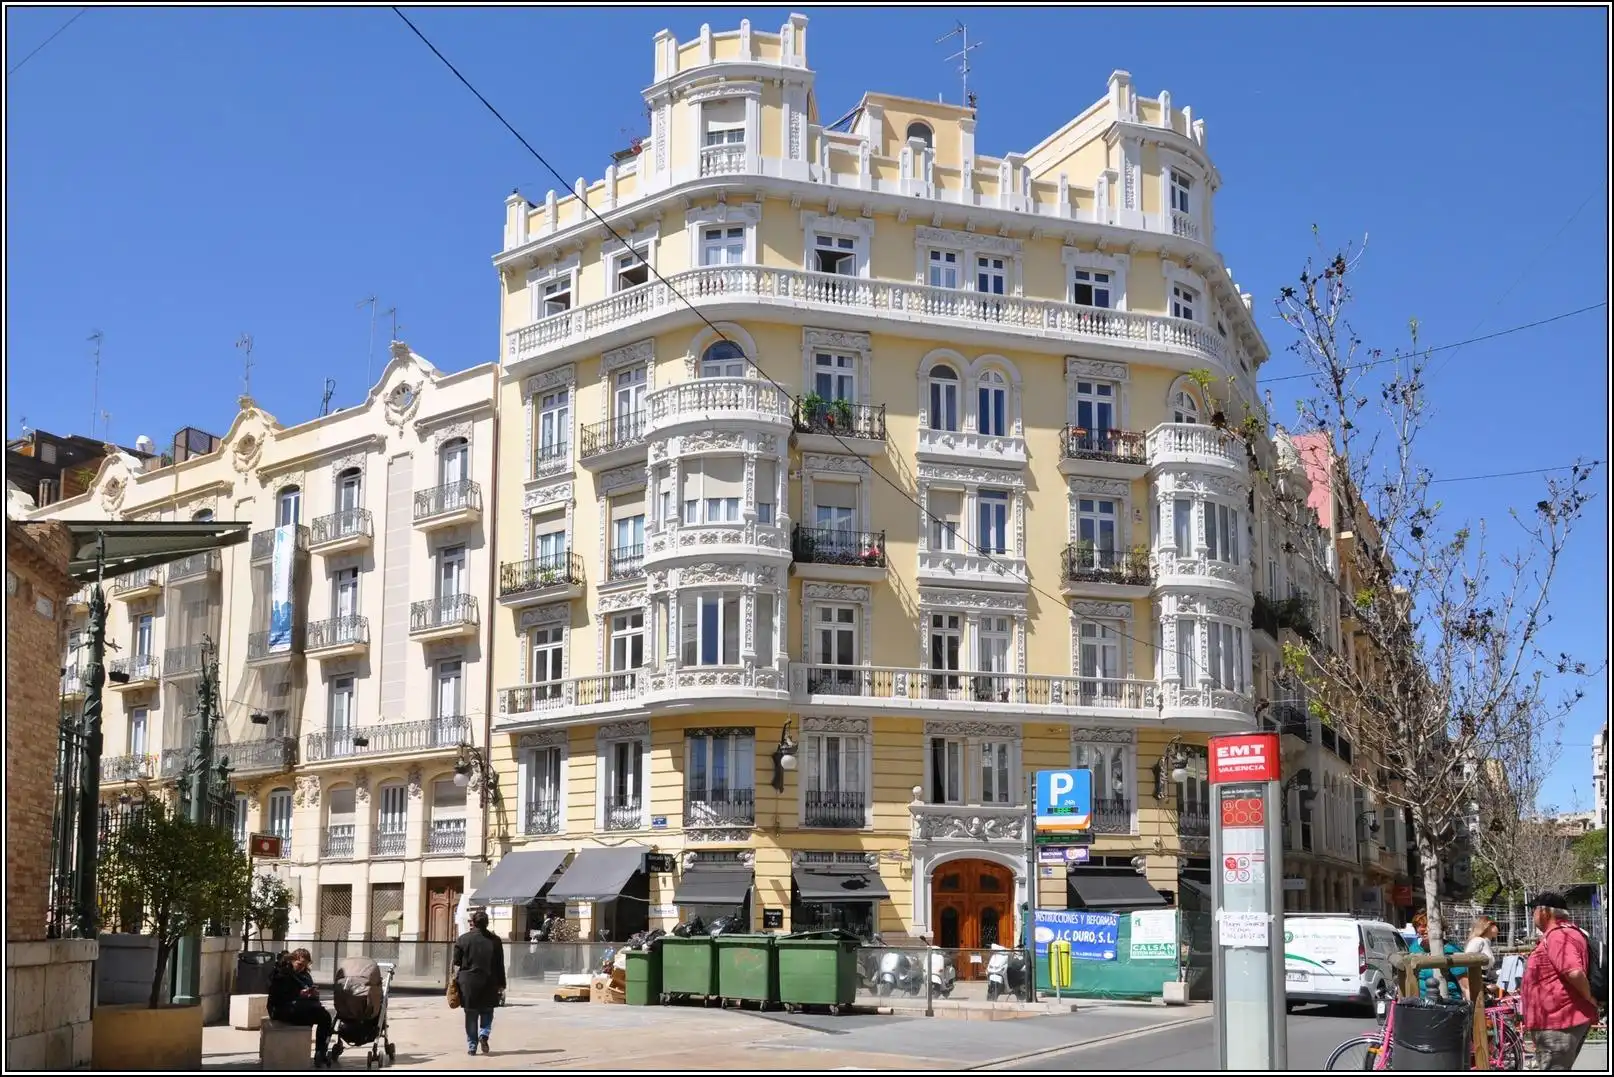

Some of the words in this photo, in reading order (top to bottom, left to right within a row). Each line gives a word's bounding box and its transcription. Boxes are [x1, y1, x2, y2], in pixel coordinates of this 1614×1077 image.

[1217, 744, 1264, 758] EMT
[1218, 764, 1265, 773] VALENCIA
[1050, 772, 1074, 806] P
[1034, 911, 1079, 924] ONSTRUCCIONES
[1080, 914, 1085, 925] Y
[1086, 914, 1117, 926] REFORMAS
[1056, 929, 1063, 941] J.
[1064, 930, 1071, 941] C.
[1072, 930, 1097, 944] DURO,
[1098, 931, 1106, 943] S.
[1106, 932, 1115, 944] L.
